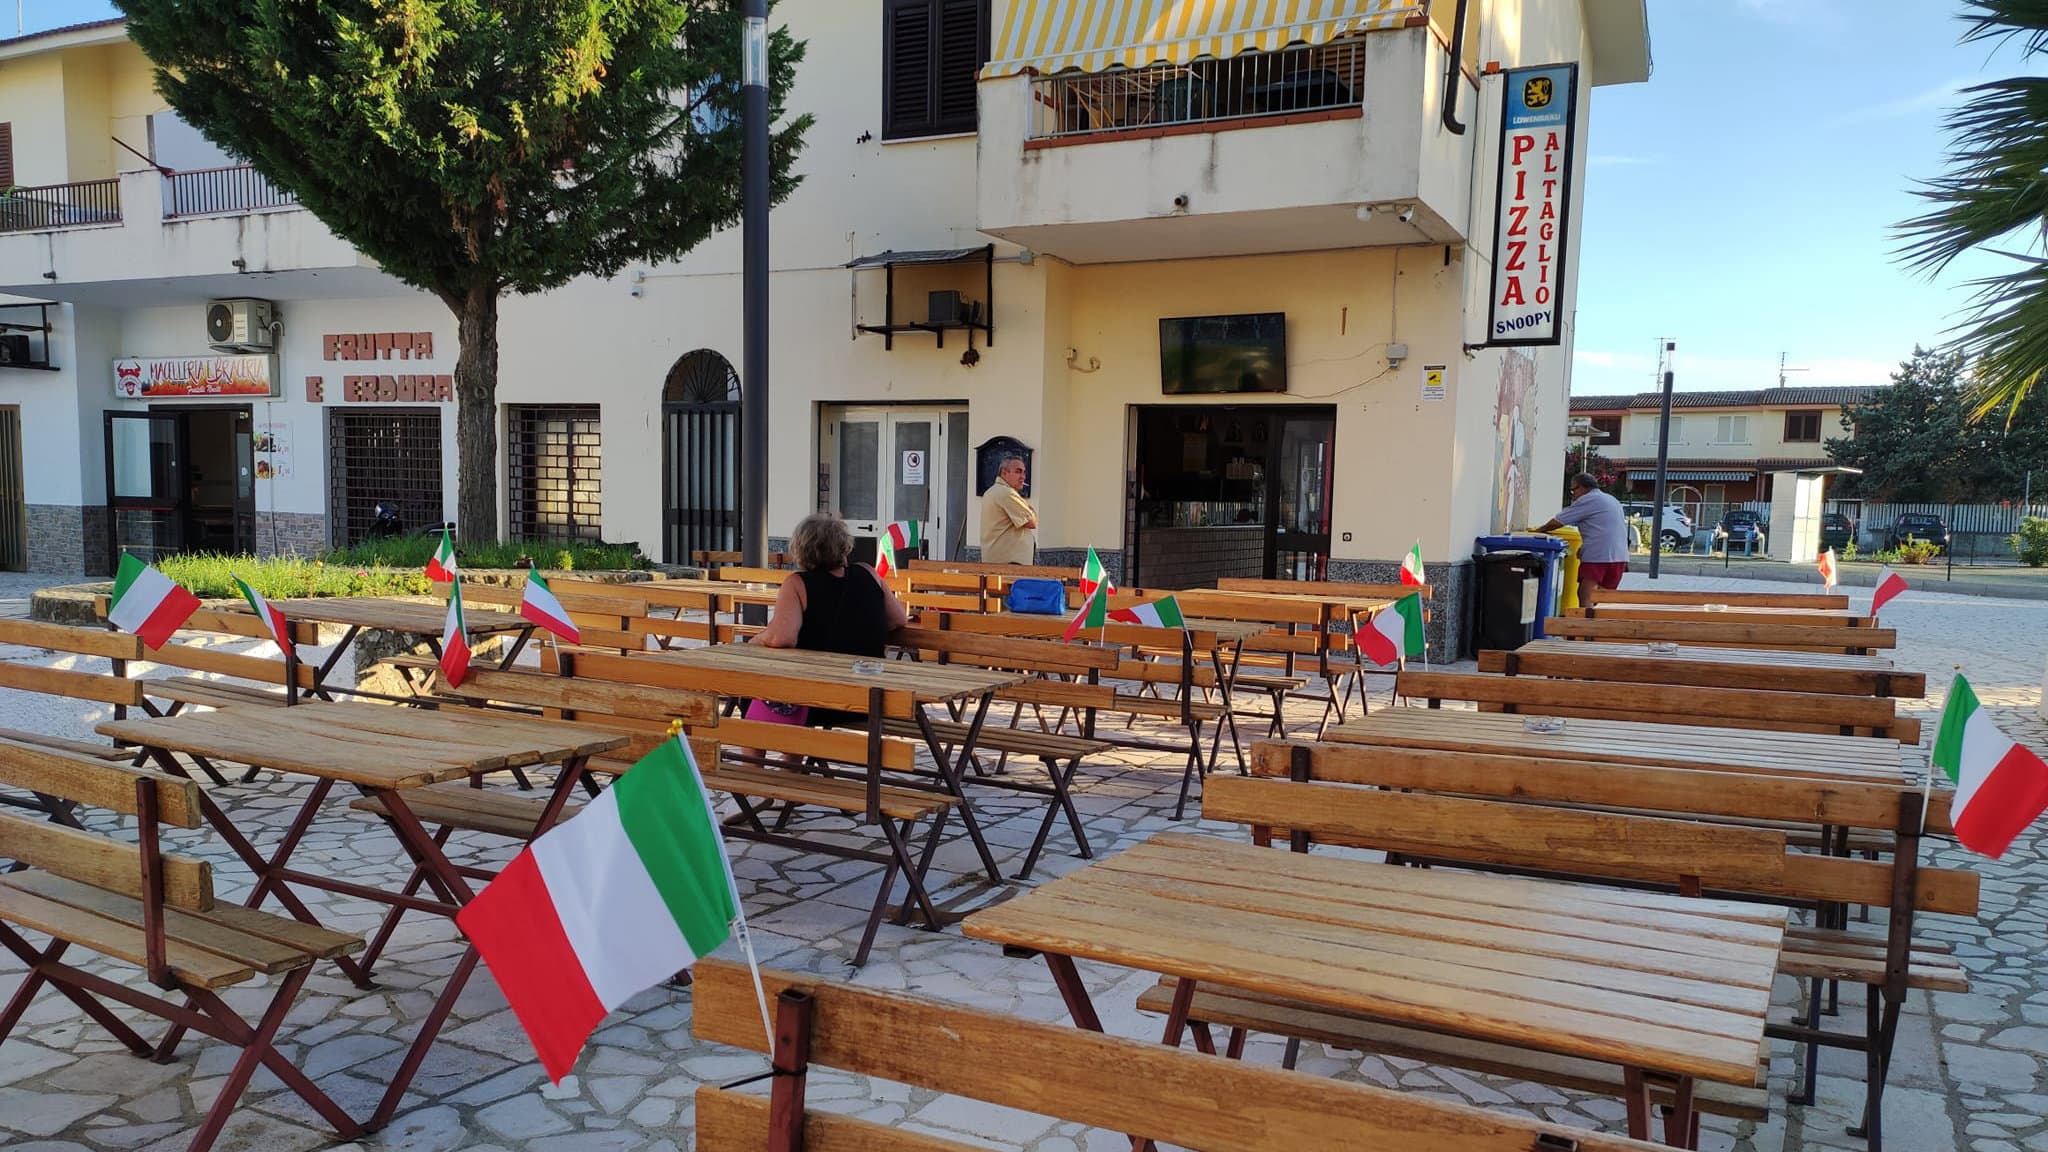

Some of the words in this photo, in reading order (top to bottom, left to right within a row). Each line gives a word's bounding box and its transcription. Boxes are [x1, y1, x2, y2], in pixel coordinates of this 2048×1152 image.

[1501, 135, 1535, 305] PIZZA
[1496, 310, 1551, 333] SNOOPY
[323, 332, 433, 360] FRUTTA
[150, 357, 201, 384] MACELLERIA
[305, 376, 323, 402] E
[343, 375, 453, 402] ERDURA
